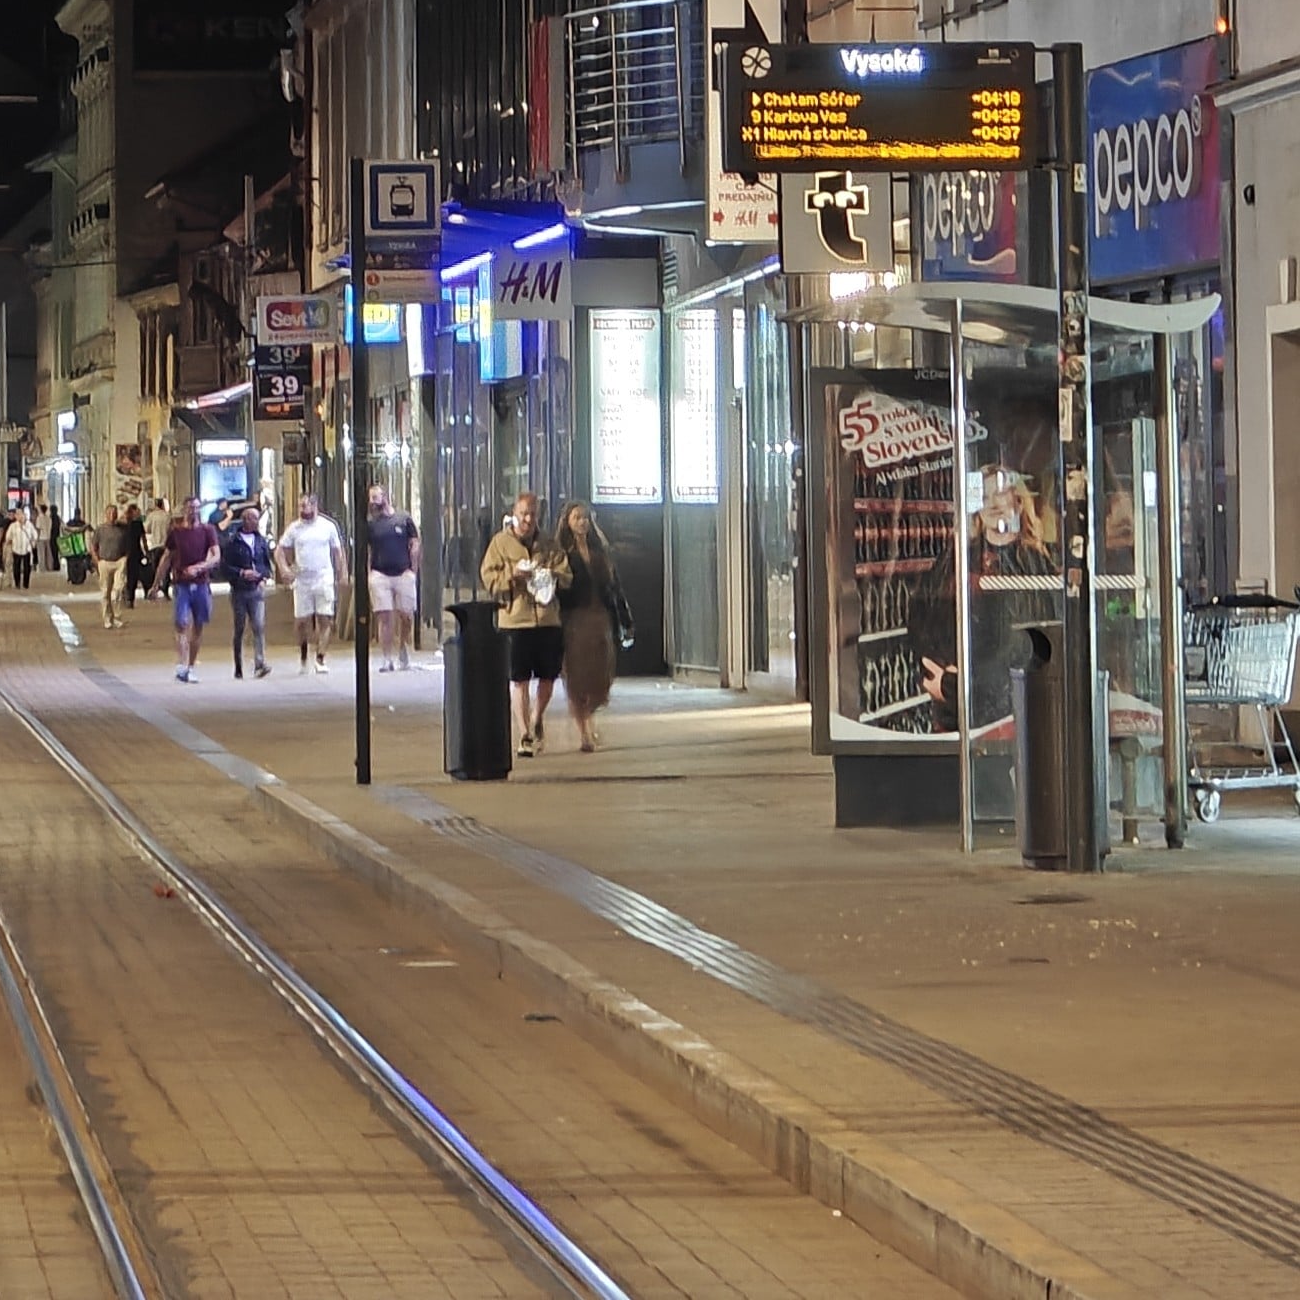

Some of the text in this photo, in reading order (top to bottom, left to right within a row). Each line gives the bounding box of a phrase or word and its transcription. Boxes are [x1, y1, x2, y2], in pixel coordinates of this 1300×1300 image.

[840, 48, 922, 77] Vysoká
[763, 92, 819, 107] Chatam
[751, 111, 761, 124] 9
[763, 110, 818, 124] Karlova
[819, 110, 847, 124] Ves
[763, 125, 812, 141] Hlavná
[813, 126, 868, 141] stanica
[1093, 109, 1193, 239] pepco
[499, 261, 563, 305] H&M
[270, 375, 299, 396] 39
[844, 401, 879, 445] 55
